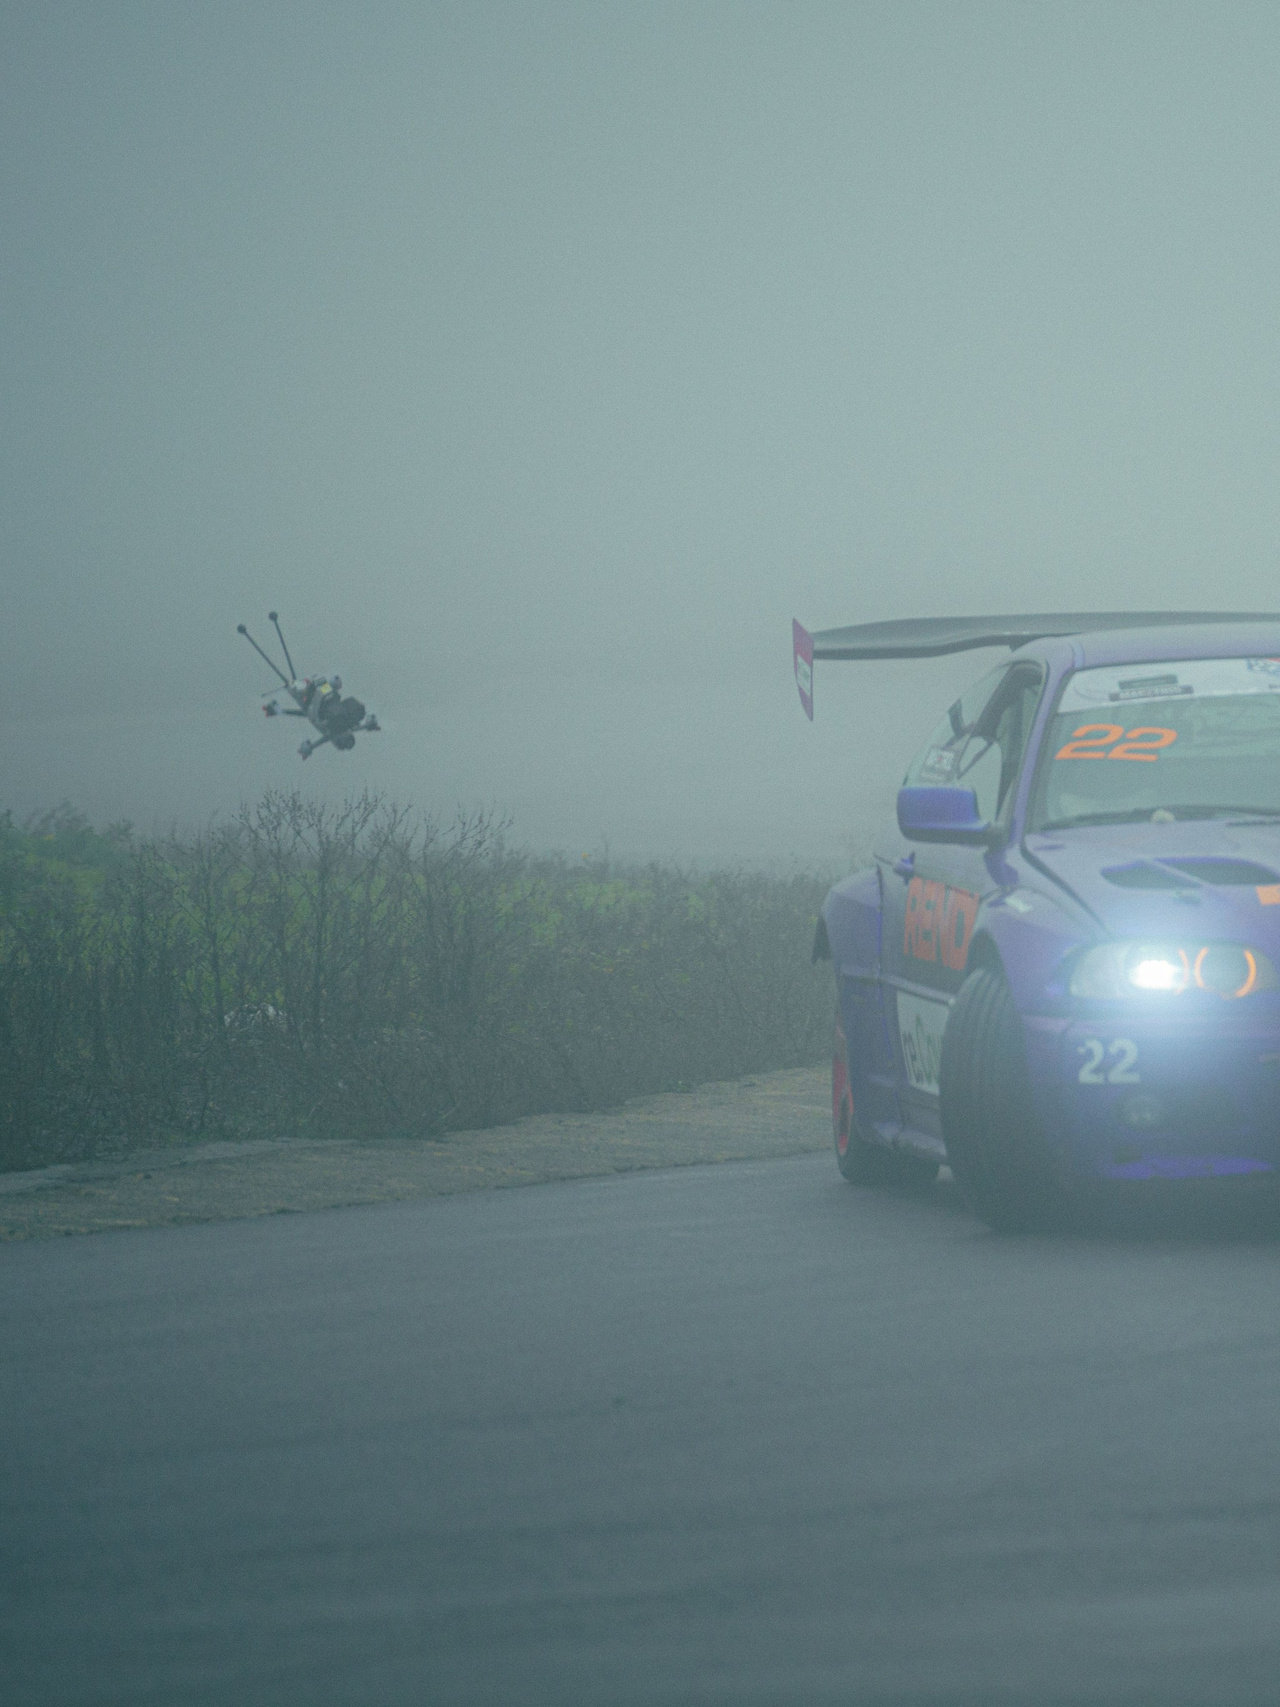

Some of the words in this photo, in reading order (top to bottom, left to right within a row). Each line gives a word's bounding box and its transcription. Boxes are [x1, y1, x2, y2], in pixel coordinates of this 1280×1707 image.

[1055, 723, 1178, 762] 22
[903, 878, 979, 970] REND
[1077, 1038, 1141, 1084] 22
